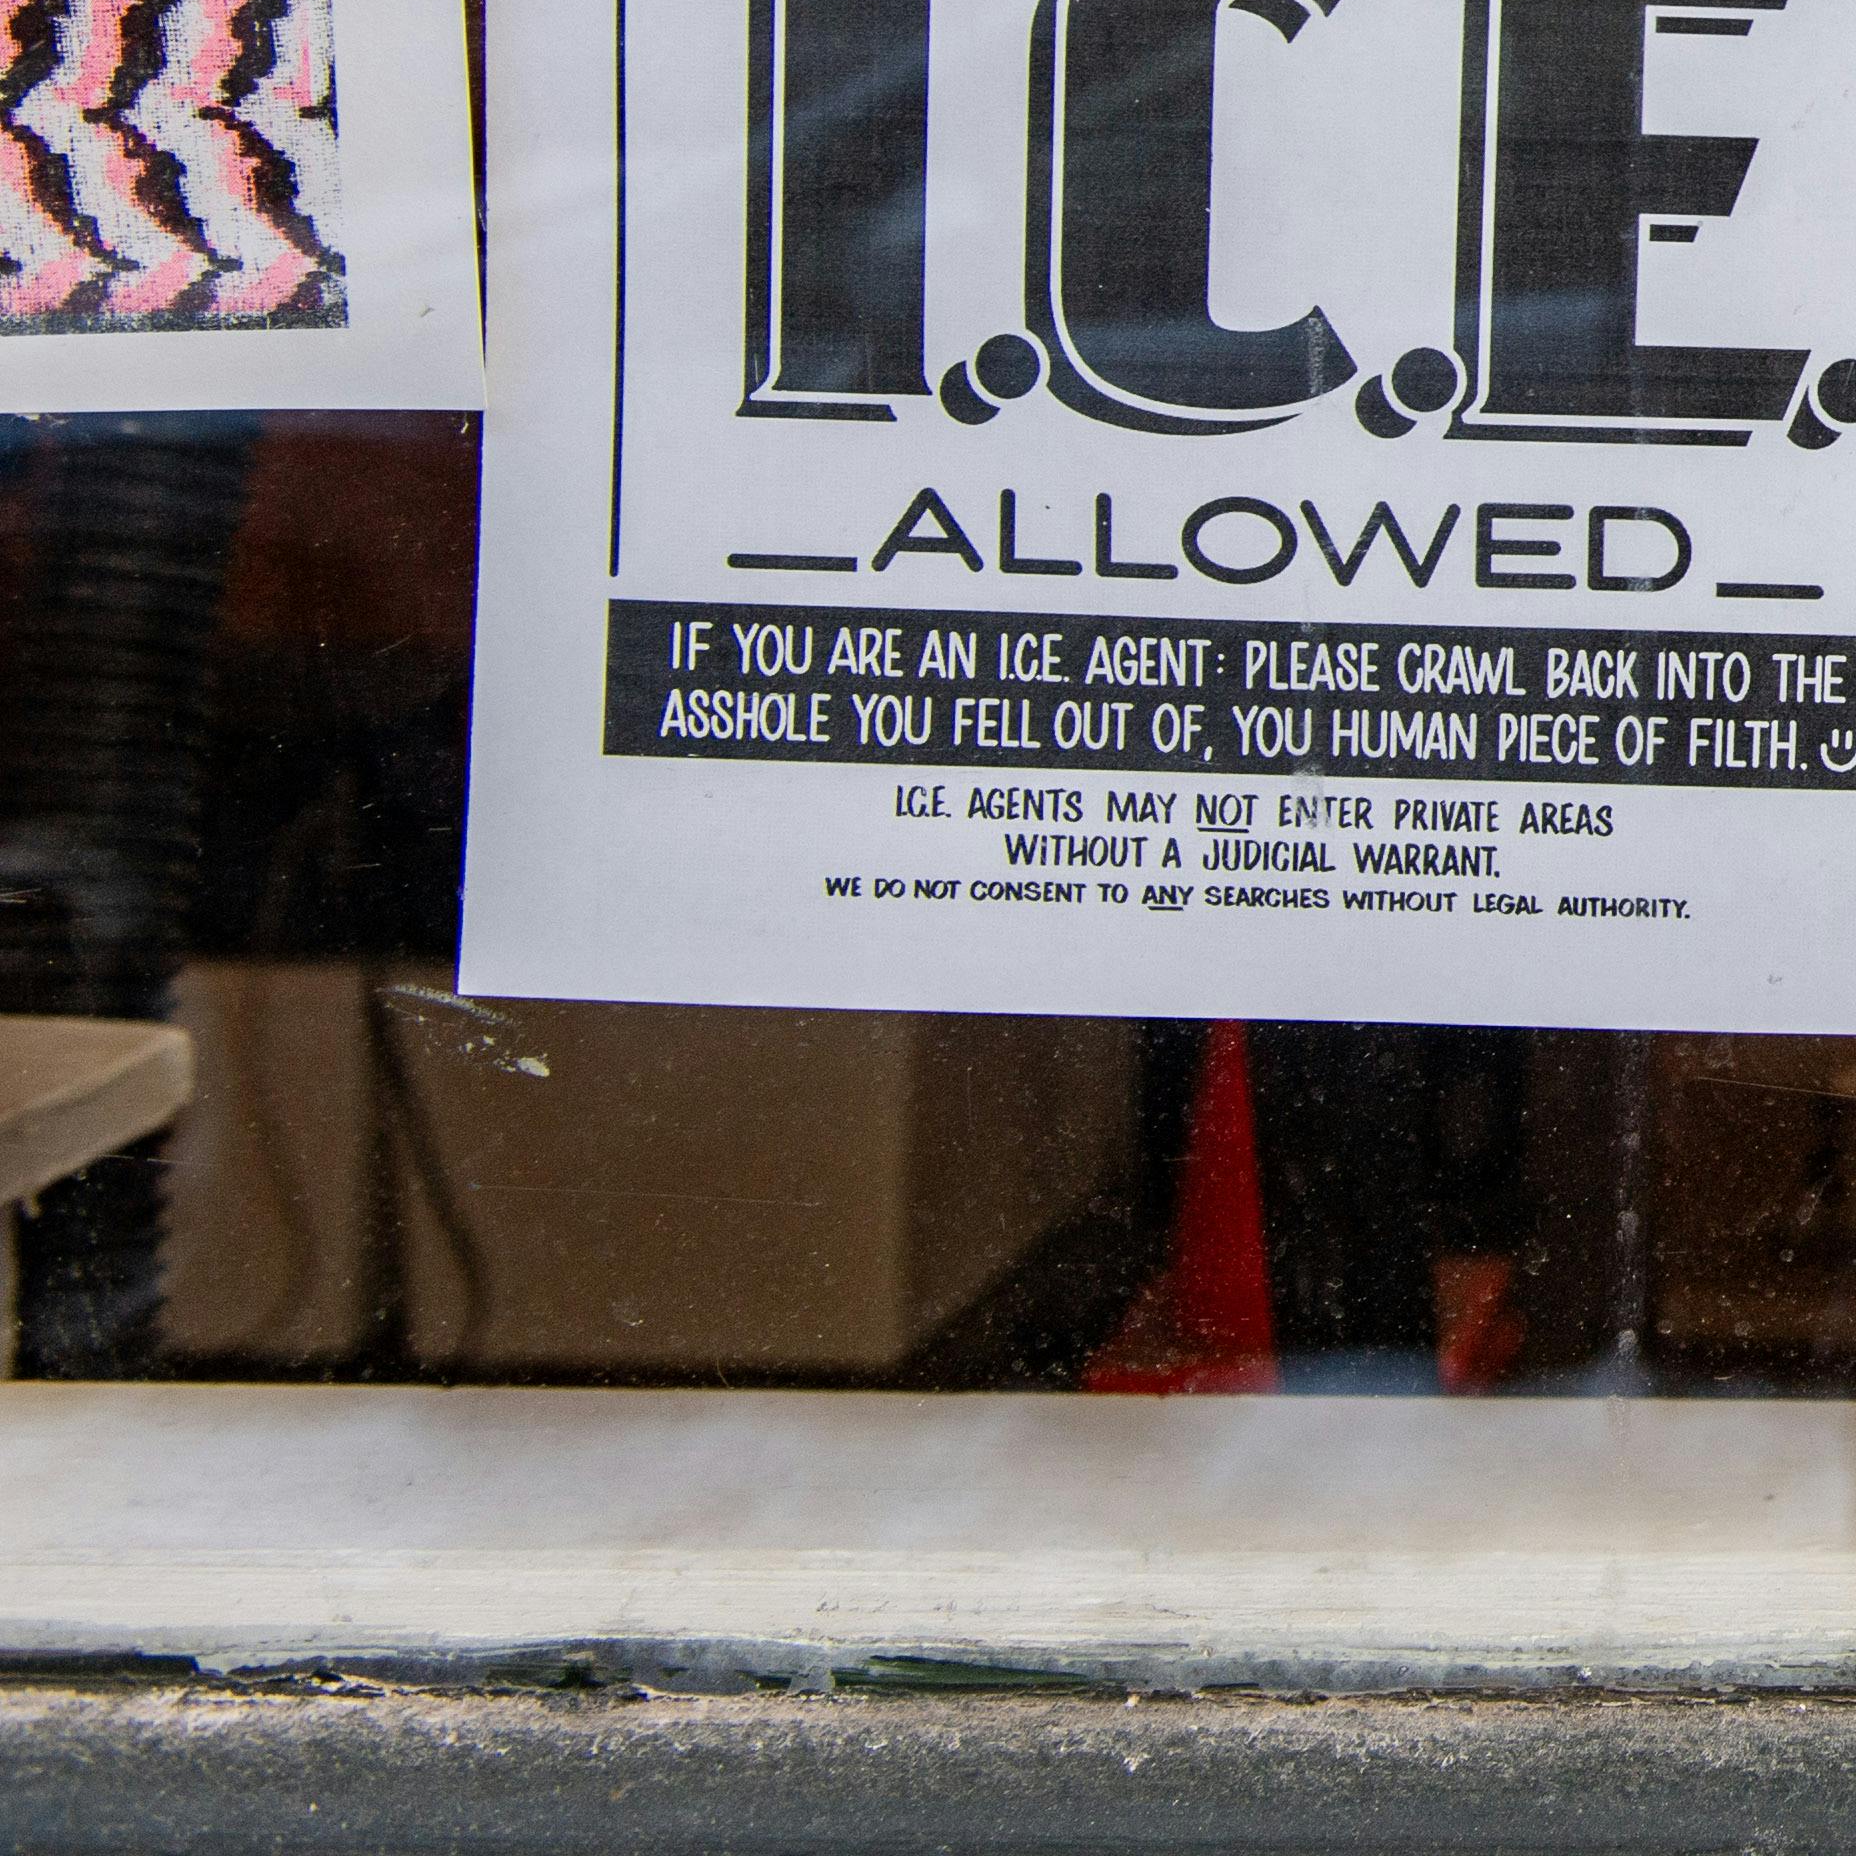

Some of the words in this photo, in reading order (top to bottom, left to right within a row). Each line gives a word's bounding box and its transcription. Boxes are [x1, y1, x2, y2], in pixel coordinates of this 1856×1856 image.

[673, 622, 712, 670] IF
[733, 623, 812, 676] YOU
[828, 628, 903, 677] ARE
[919, 630, 976, 679] AN
[1000, 633, 1069, 682] I.C.E.
[1246, 641, 1379, 691] PLEASE
[1398, 643, 1526, 695] CRAWL
[1547, 648, 1639, 698] BACK
[1658, 651, 1750, 702] INTO
[1772, 654, 1846, 703] THE
[661, 689, 831, 742] ASSHOLE
[852, 694, 931, 746] YOU
[954, 698, 1040, 748] FELL
[1054, 701, 1133, 750] OUT
[1152, 703, 1212, 761] OF,
[1233, 705, 1311, 757] YOU
[1333, 709, 1477, 760] HUMAN
[1499, 713, 1600, 764] PIECE
[1616, 715, 1668, 765] OF
[1690, 718, 1807, 770] FILTH.
[896, 785, 951, 817] I.C.E.
[968, 787, 1083, 822] AGENTS
[1107, 791, 1177, 823] MAY
[1196, 794, 1258, 825] NOT
[1279, 795, 1373, 829] ENTER
[1395, 799, 1499, 832] PRIVATE
[1520, 802, 1613, 836] AREAS
[1005, 834, 1148, 867] WITHOUT
[1162, 838, 1181, 868] A
[1203, 839, 1336, 872] JUDICIAL
[1353, 843, 1500, 878] WARRANT.
